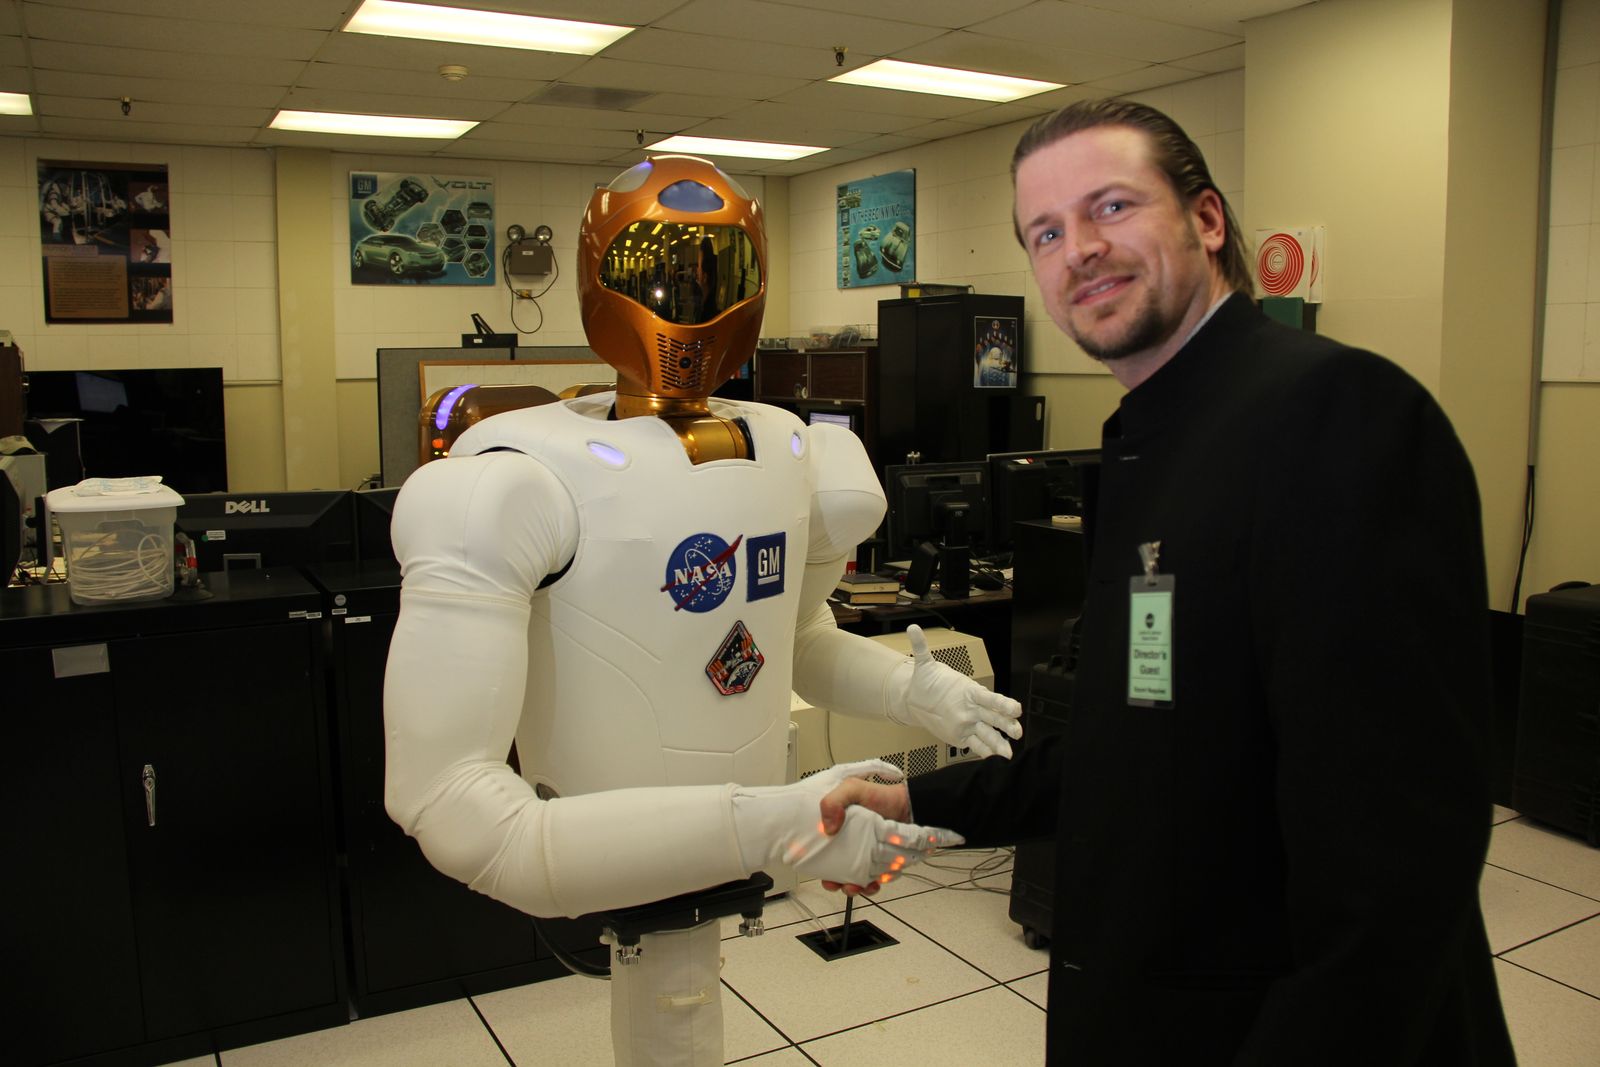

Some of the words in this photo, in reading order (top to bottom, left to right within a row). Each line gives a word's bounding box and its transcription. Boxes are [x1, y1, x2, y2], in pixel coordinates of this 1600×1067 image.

[357, 179, 372, 192] GM
[431, 176, 492, 192] VOLT
[225, 500, 270, 514] DELL
[757, 546, 780, 577] GM
[674, 561, 733, 586] NASA
[1133, 649, 1167, 661] Director's
[1139, 665, 1160, 675] Guest
